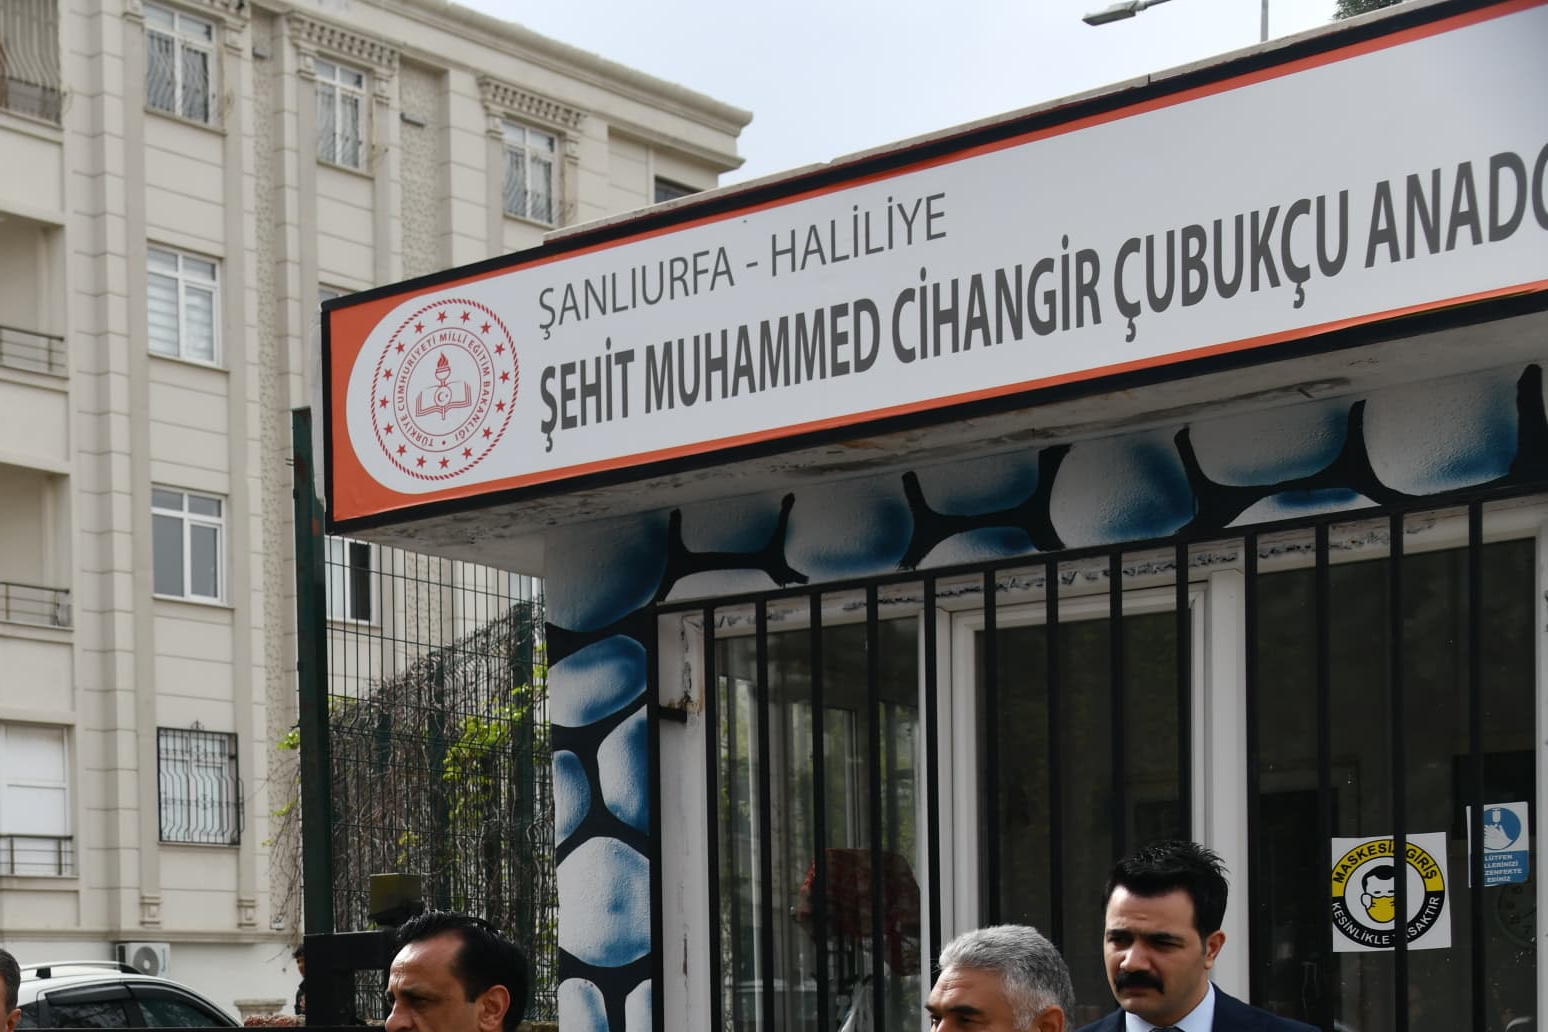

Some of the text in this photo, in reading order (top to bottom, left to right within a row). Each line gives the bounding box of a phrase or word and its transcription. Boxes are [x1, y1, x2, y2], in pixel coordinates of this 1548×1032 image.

[539, 246, 736, 340] ŞANLIURFA
[771, 192, 947, 277] HALİLİYE
[540, 336, 635, 453] ŞEHİT
[645, 298, 881, 414] MUHAMMED
[892, 234, 1102, 364] CİHANGİR
[1114, 189, 1349, 343] ÇUBUKÇU
[400, 413, 434, 447] TÜRKİYE
[439, 331, 468, 344] MİLLİ
[1332, 841, 1396, 884] MASKESİ
[1484, 860, 1519, 868] LLERİNİZİ
[1332, 896, 1441, 945] KESİNLİKLE SAKTIR
